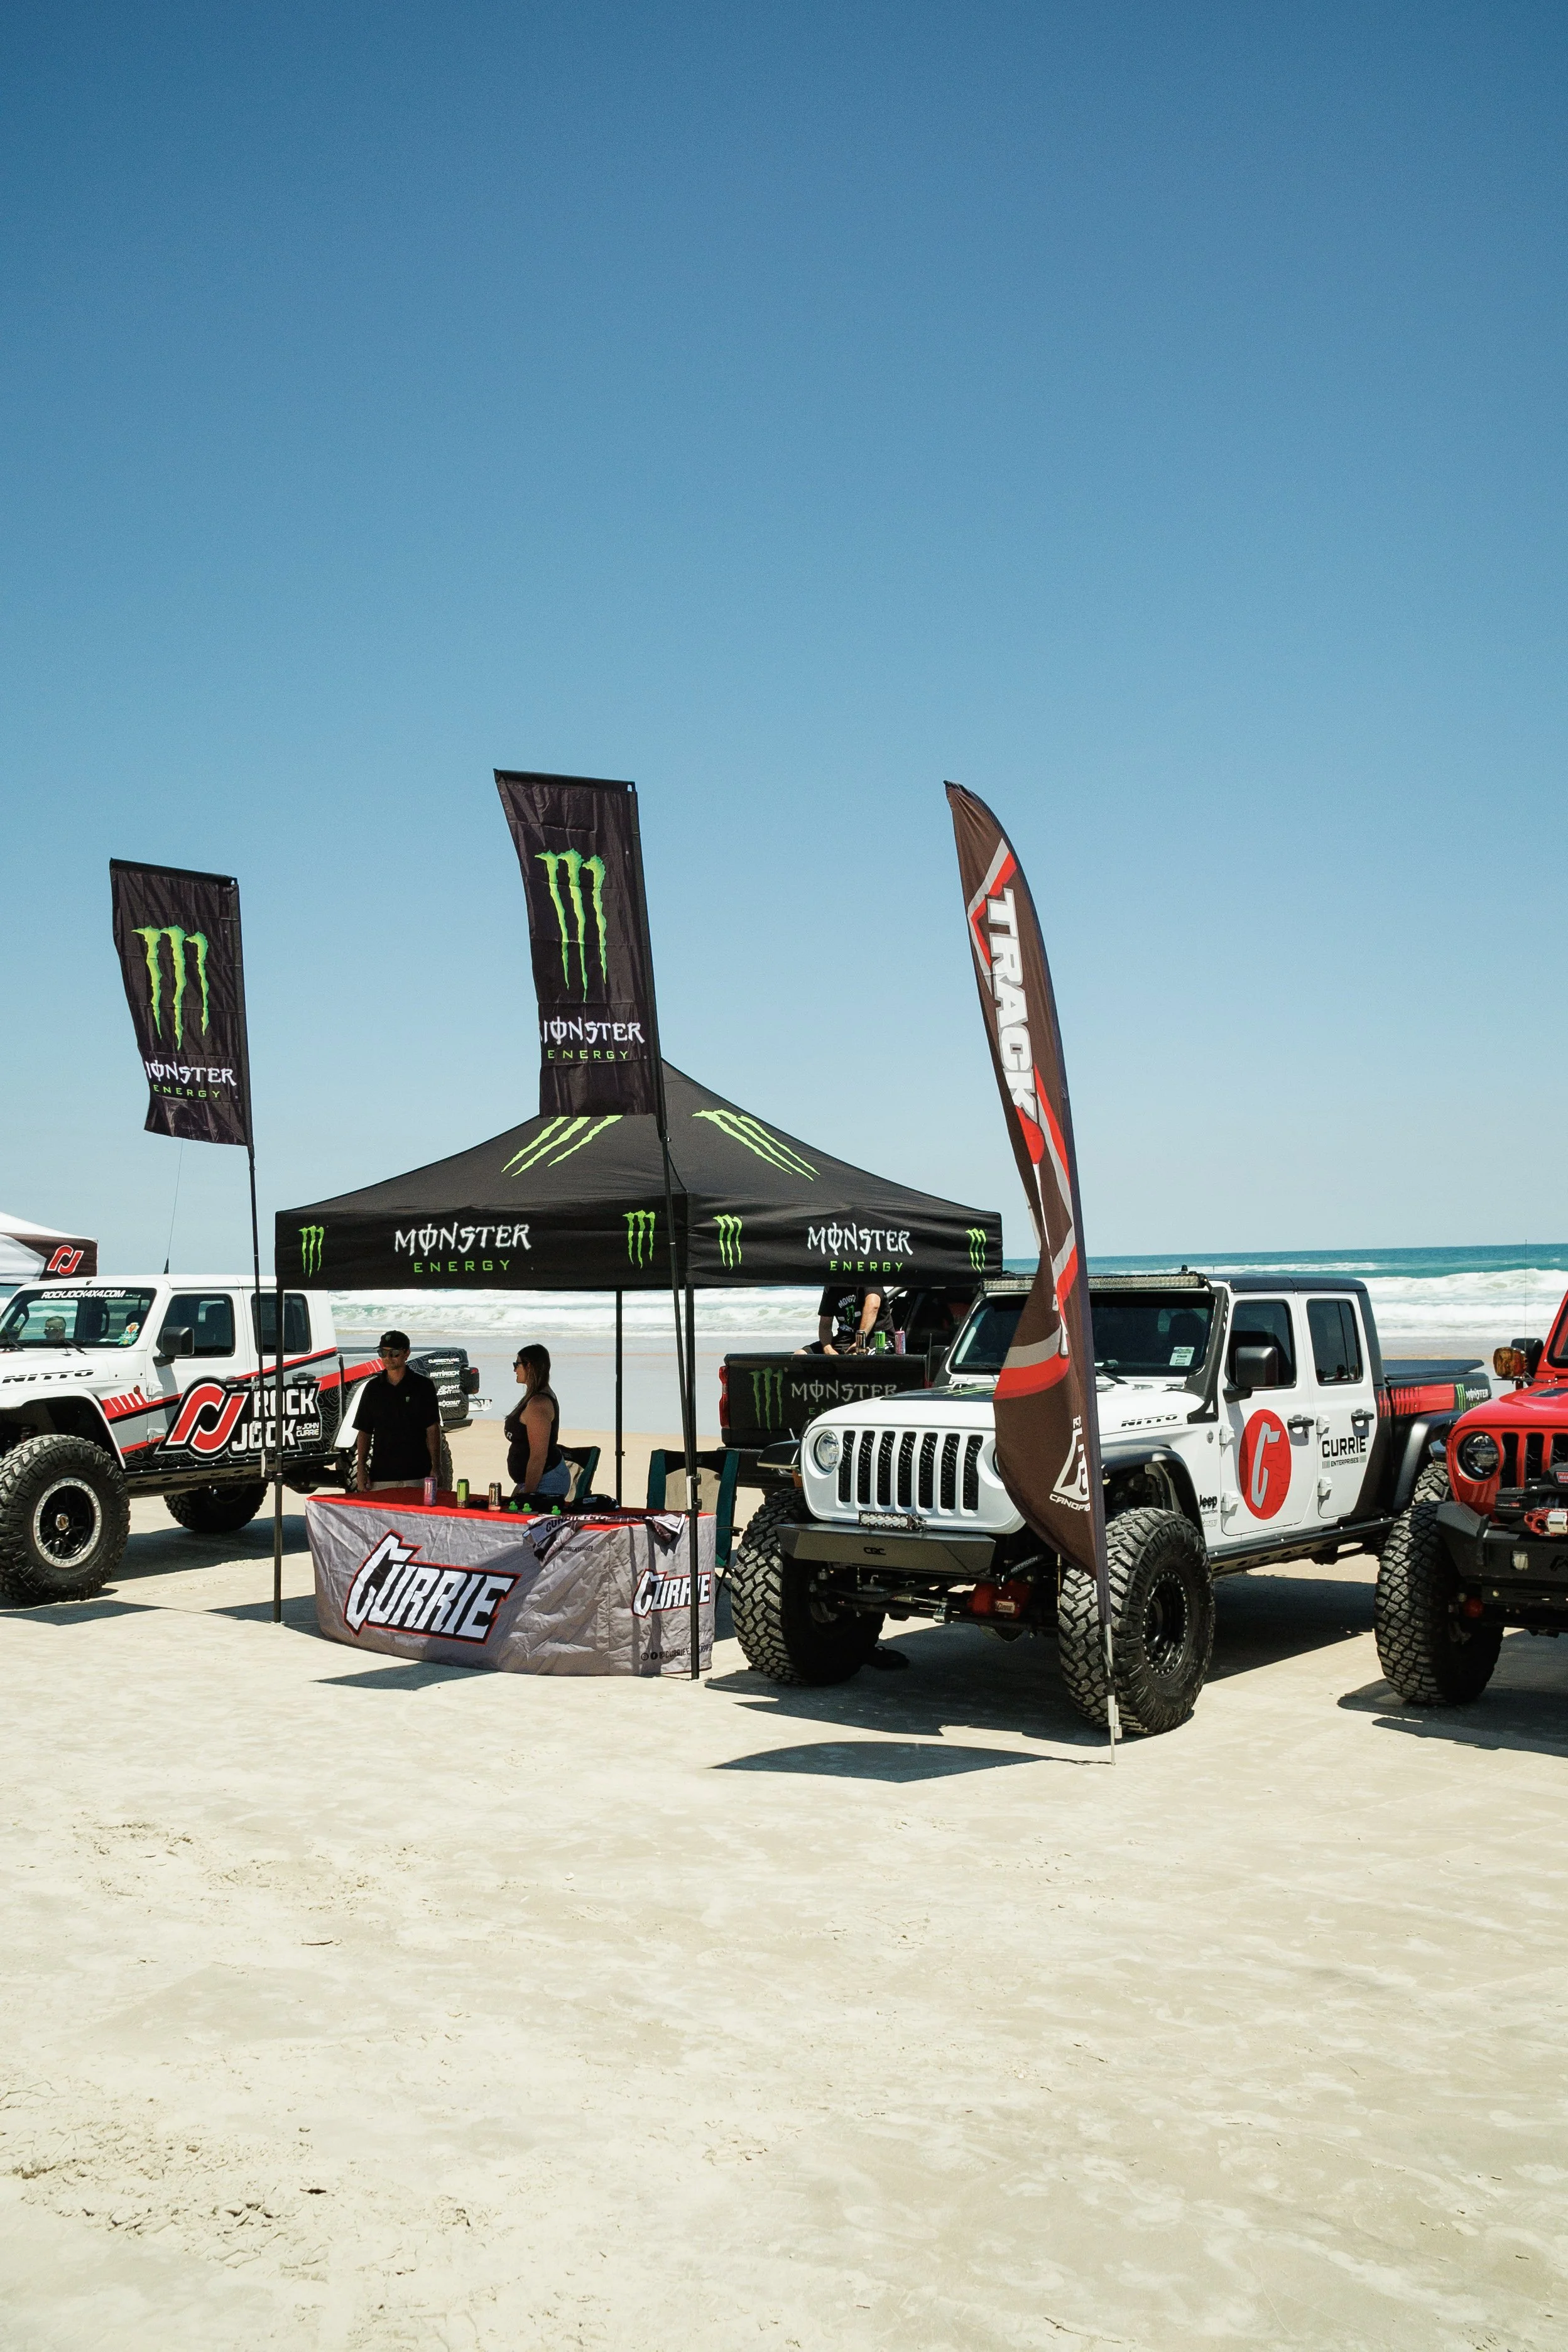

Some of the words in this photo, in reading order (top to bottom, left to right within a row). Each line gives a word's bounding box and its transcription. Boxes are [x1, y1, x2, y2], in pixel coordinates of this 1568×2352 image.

[547, 1050, 628, 1059] ENERGY
[153, 1084, 220, 1097] ENERGY
[395, 1221, 531, 1256] MONSTER
[807, 1222, 913, 1256] MONSTER
[414, 1260, 510, 1273] ENERGY
[830, 1260, 903, 1272] ENERGY
[41, 1290, 126, 1299] ROCKJOCK4X4.COM
[3, 1369, 94, 1383] NITTO
[1121, 1414, 1178, 1427] NITTO
[1322, 1435, 1366, 1458] CURRIE
[1331, 1457, 1359, 1467] ENTERPRISES
[1199, 1494, 1217, 1509] Jeep
[346, 1533, 515, 1640] CURRIE
